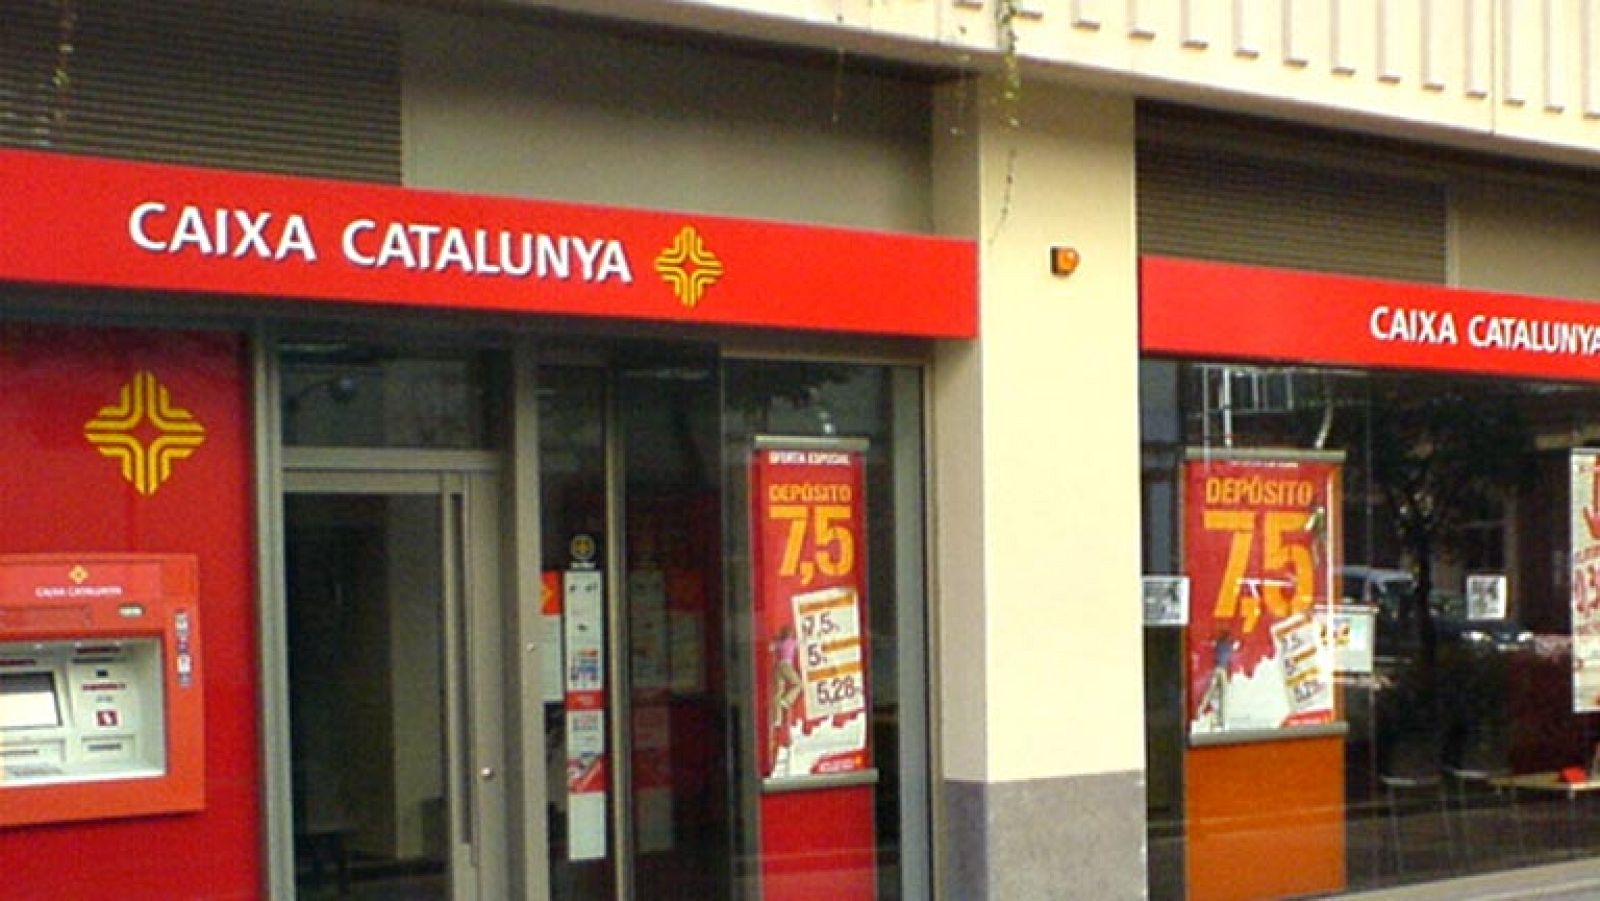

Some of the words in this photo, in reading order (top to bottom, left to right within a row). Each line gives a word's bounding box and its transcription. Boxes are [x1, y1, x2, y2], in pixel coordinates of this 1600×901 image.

[128, 201, 318, 263] CAIXA
[341, 218, 634, 285] CATALUNYA
[1370, 305, 1458, 345] CAIXA
[768, 480, 852, 503] DEPÓSITO
[1206, 474, 1313, 506] DEPÓSITO
[768, 505, 855, 586] 7,5
[1203, 510, 1314, 633] 7,5
